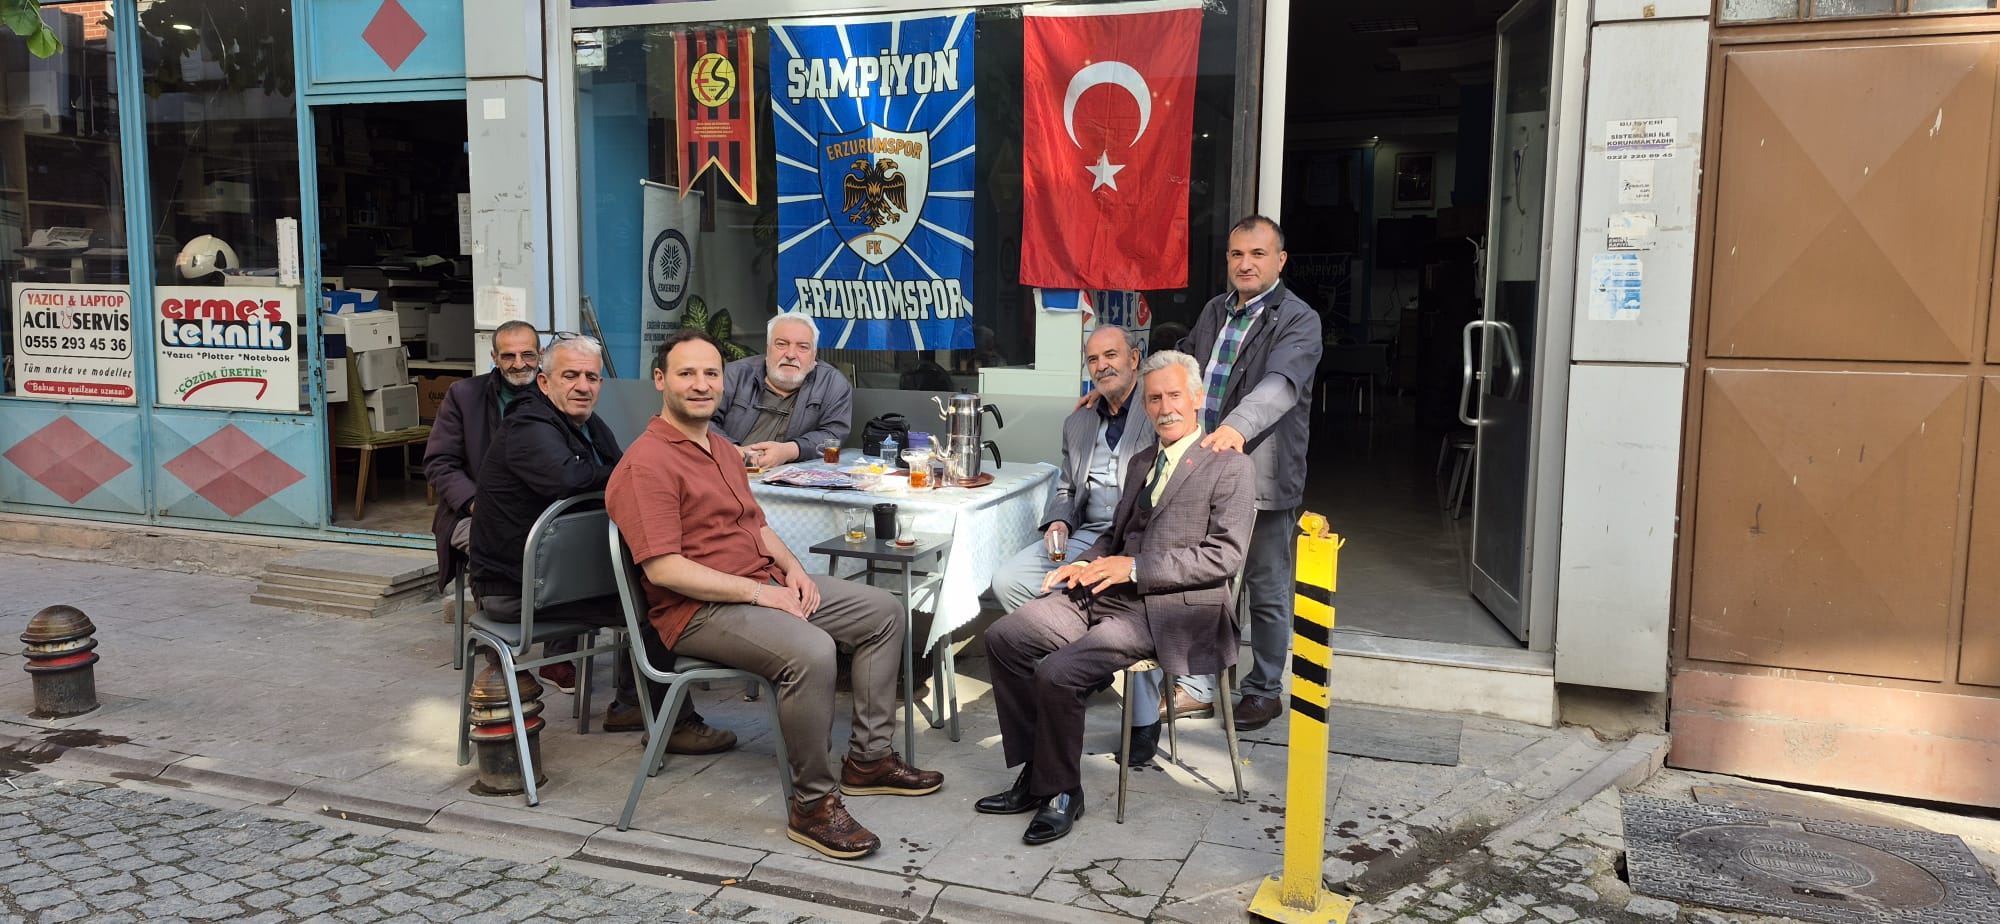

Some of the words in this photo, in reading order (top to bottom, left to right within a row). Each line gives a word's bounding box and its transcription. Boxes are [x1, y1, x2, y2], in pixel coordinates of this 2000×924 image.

[787, 48, 959, 105] ŞAMPİYON
[826, 137, 923, 161] ERZURUMSPOR
[866, 240, 883, 255] FK
[27, 293, 64, 306] YAZICI
[68, 295, 76, 307] &
[80, 294, 124, 307] LAPTOP
[794, 278, 965, 321] ERZURUMSPOR
[23, 307, 60, 329] ACİL
[72, 309, 130, 331] SERVİS
[25, 335, 58, 349] 0555
[61, 336, 86, 350] 293
[89, 338, 106, 351] 45
[110, 339, 127, 352] 36
[163, 315, 285, 350] teknik
[24, 362, 41, 373] Tüm
[45, 365, 73, 375] marka
[78, 367, 87, 375] ve
[91, 366, 132, 378] modeller
